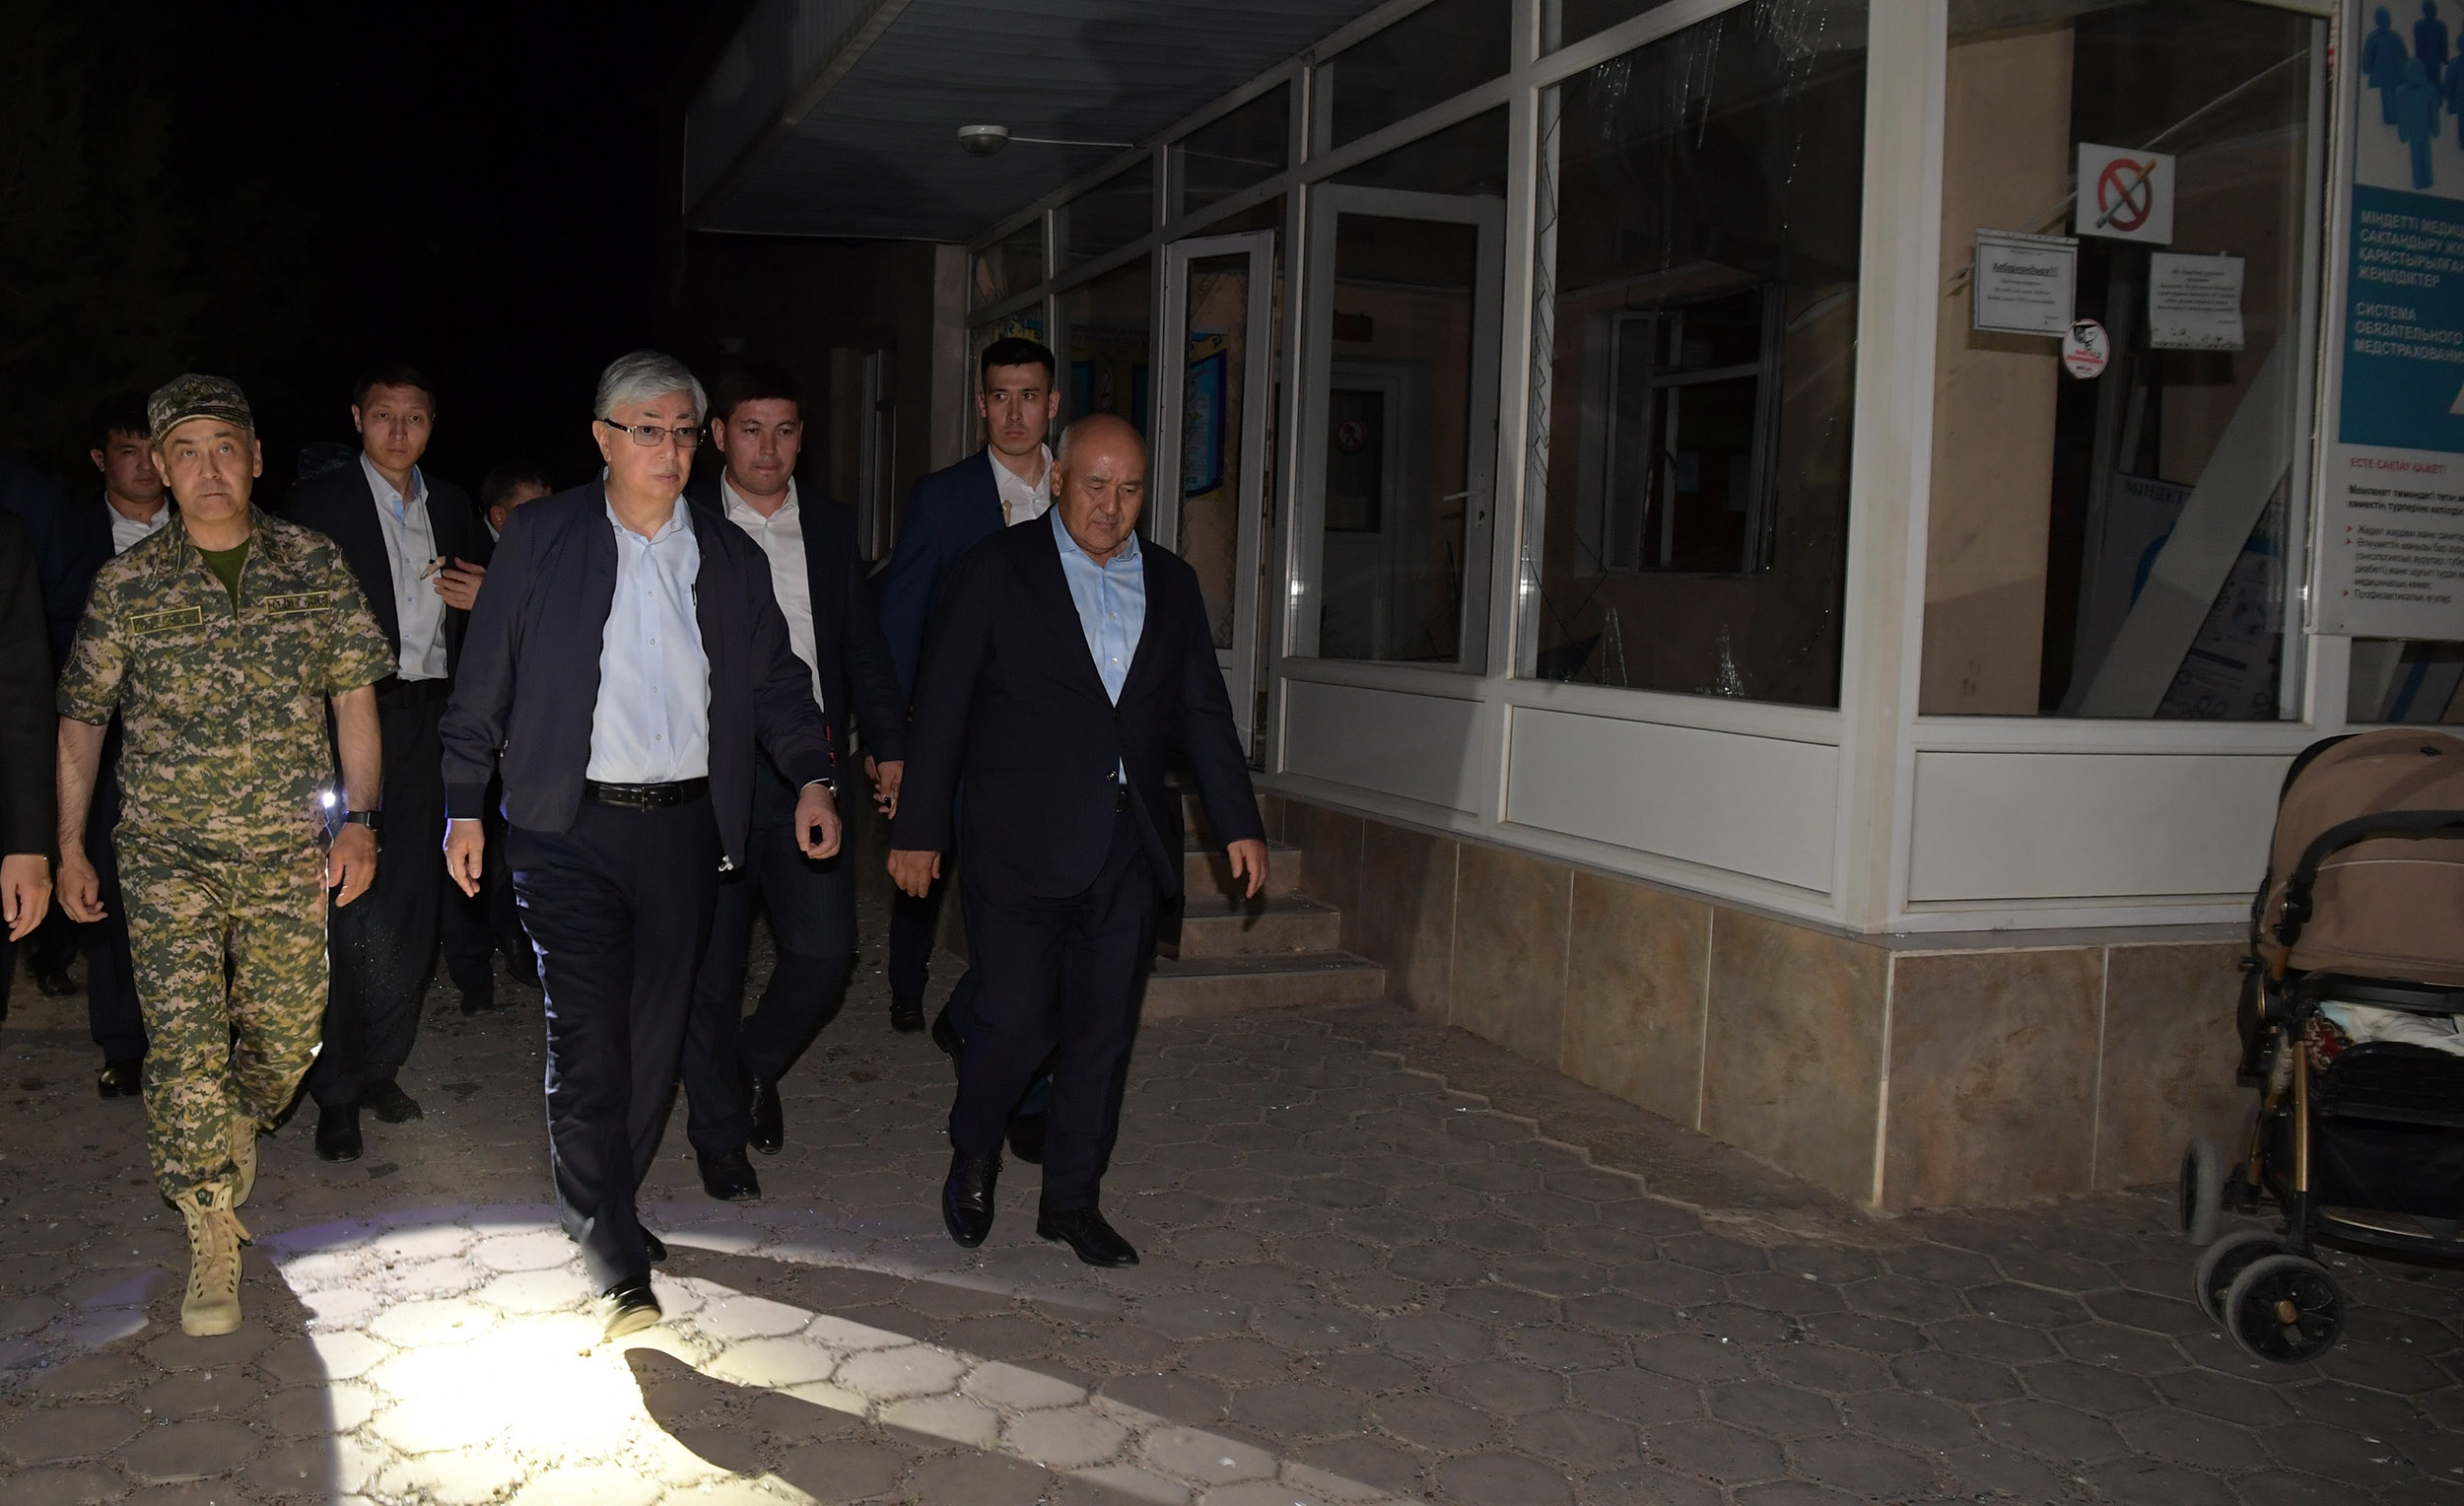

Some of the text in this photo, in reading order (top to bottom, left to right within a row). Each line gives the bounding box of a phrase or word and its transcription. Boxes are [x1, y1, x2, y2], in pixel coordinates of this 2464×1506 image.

[2357, 302, 2417, 320] СИСТЕМА
[2355, 320, 2463, 345] ОБЯЗАТЕЛЬНОГО
[2350, 457, 2374, 468] ЕСТЕ
